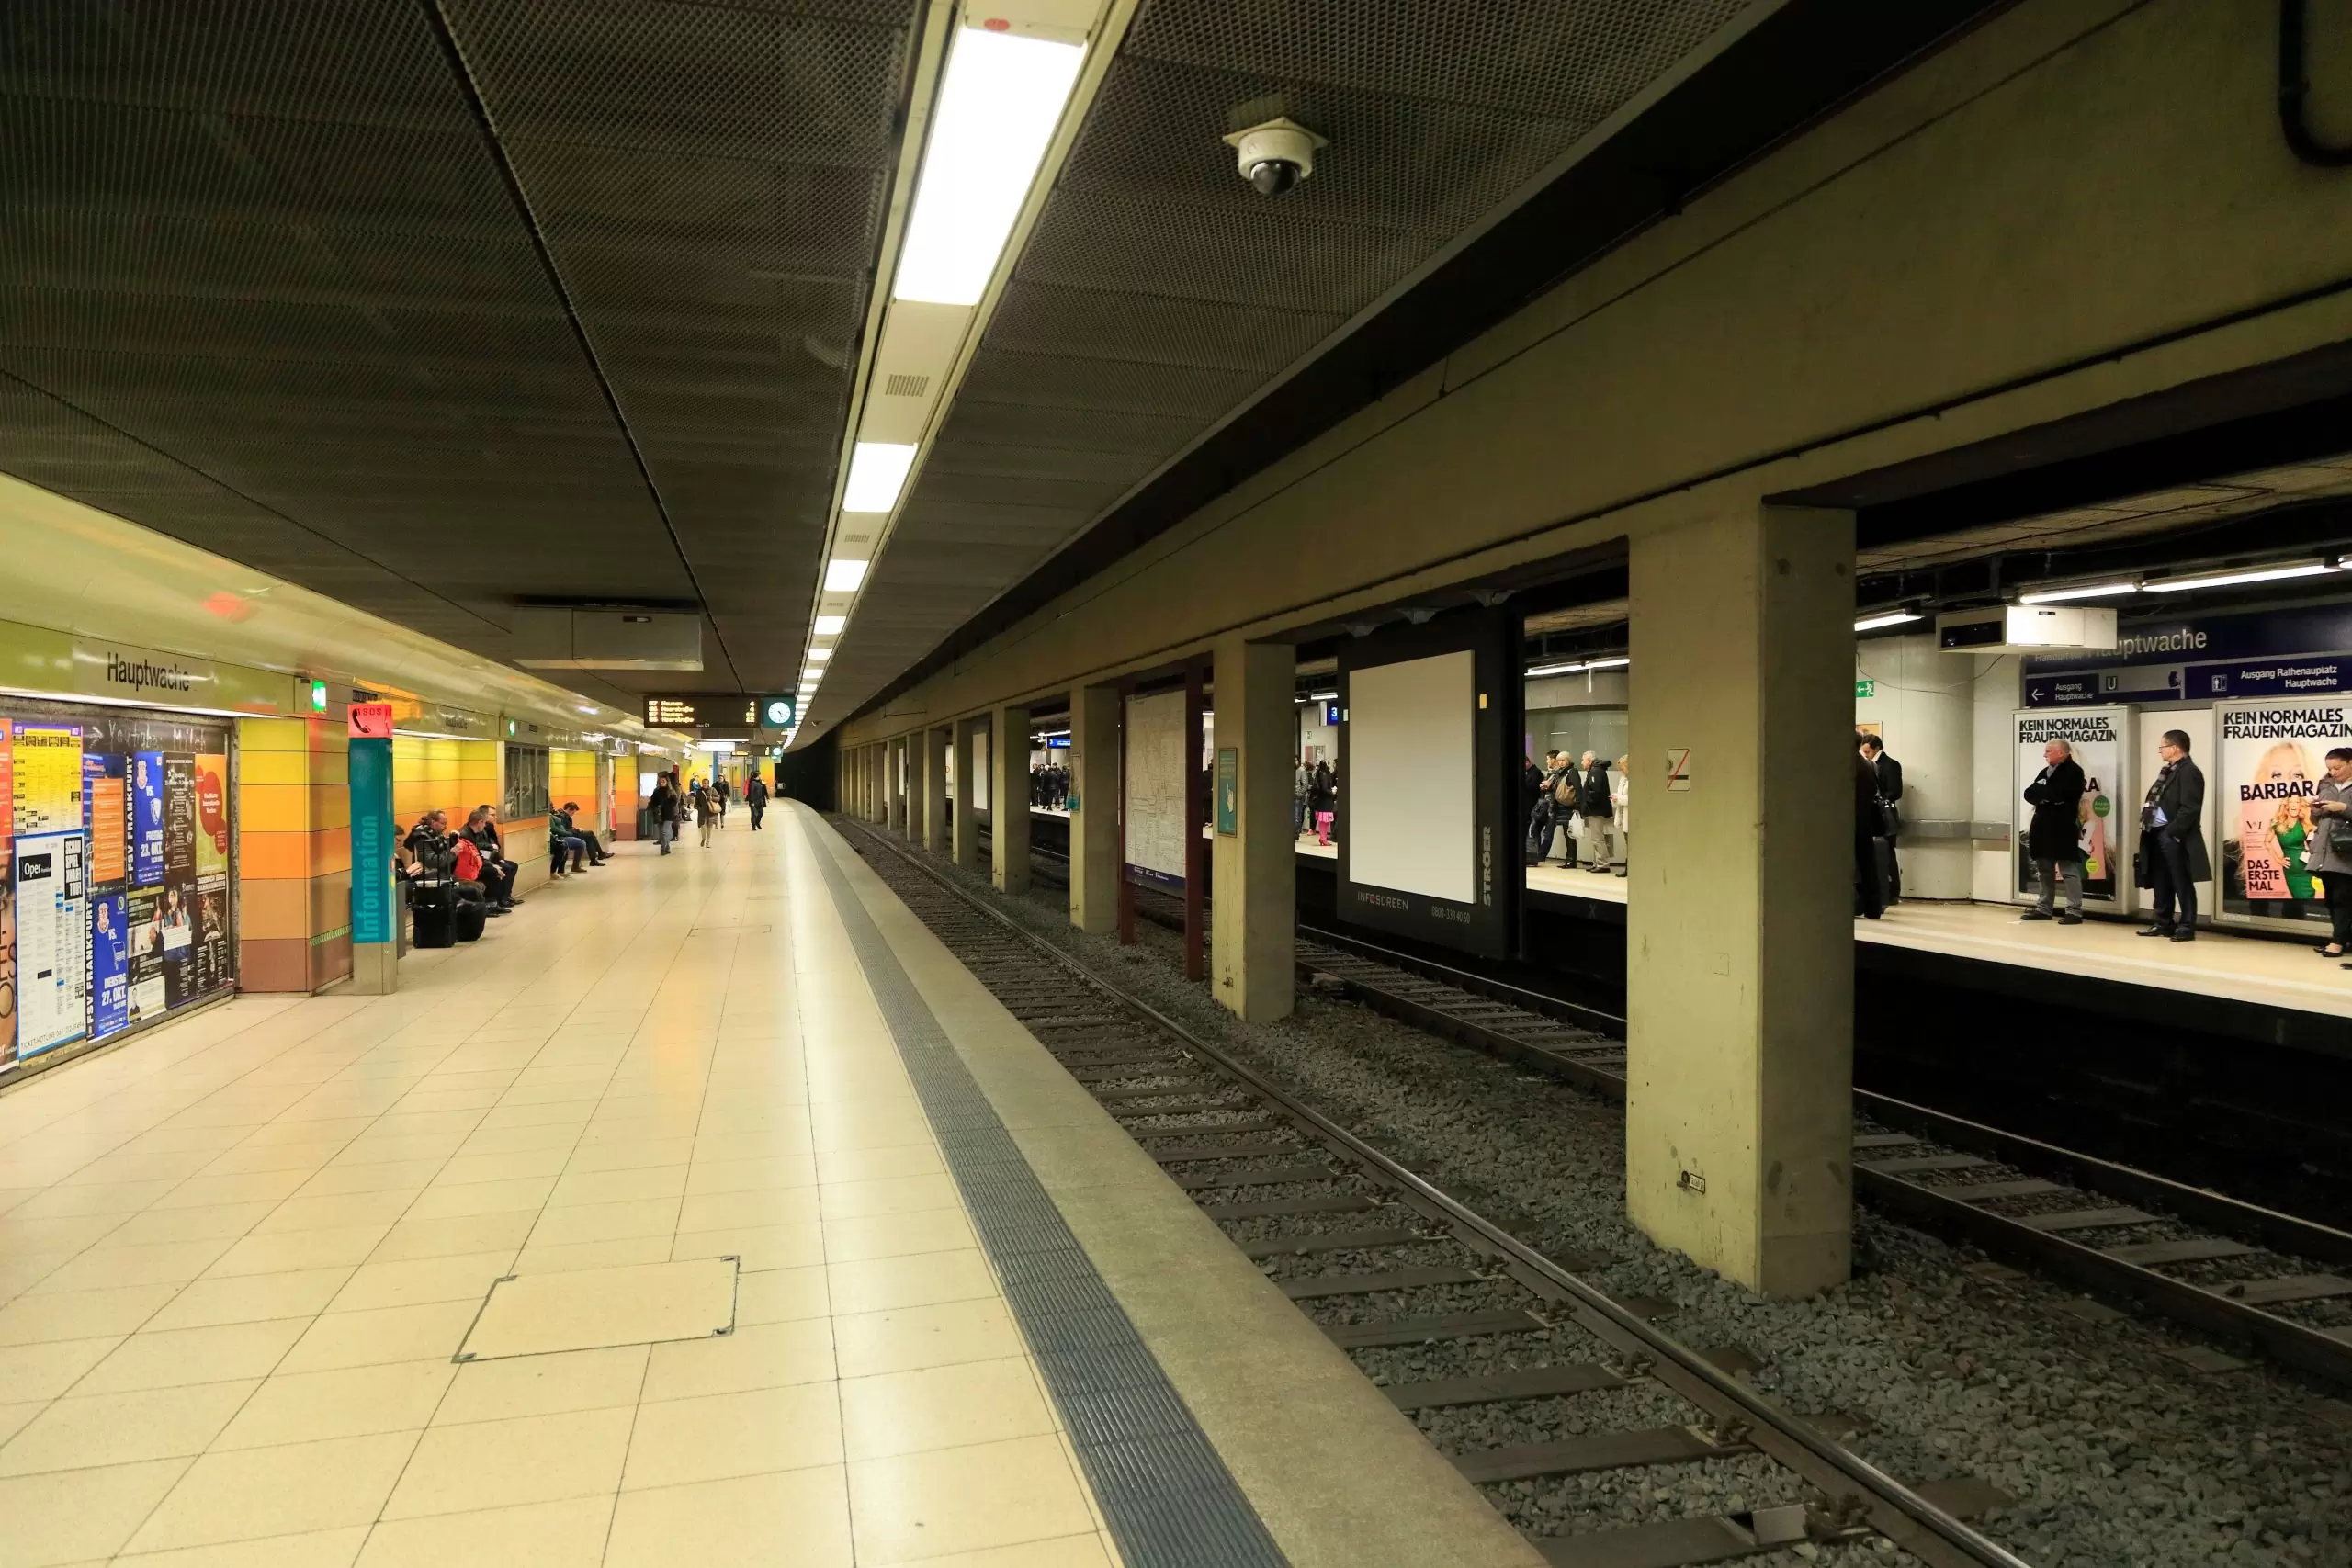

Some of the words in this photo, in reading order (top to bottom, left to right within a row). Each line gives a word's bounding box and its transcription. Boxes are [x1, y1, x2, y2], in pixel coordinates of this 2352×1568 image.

[107, 652, 190, 691] Hauptwache
[2241, 671, 2276, 681] Ausgang
[2277, 665, 2338, 678] Rathenauplatz
[2055, 682, 2082, 694] Ausgang
[2108, 678, 2116, 690] U
[2285, 677, 2337, 688] Hauptwache
[2055, 692, 2094, 702] Hauptwache
[363, 707, 382, 716] SOS
[1331, 707, 1338, 716] 3
[2224, 712, 2256, 725] KEIN
[2260, 708, 2344, 725] NORMALES
[2019, 719, 2045, 732] KEIN
[2046, 716, 2109, 731] NORMALES
[2224, 724, 2352, 739] FRAUENMAGAZIN
[126, 756, 134, 840] FRANKFURT
[24, 862, 41, 878] Oper
[2247, 860, 2269, 869] DAS
[356, 815, 379, 940] Information
[2248, 870, 2280, 880] ERSTE
[2248, 880, 2274, 891] MAL
[1357, 891, 1409, 911] INFOSCREEN
[85, 901, 94, 990] FRANKFURT
